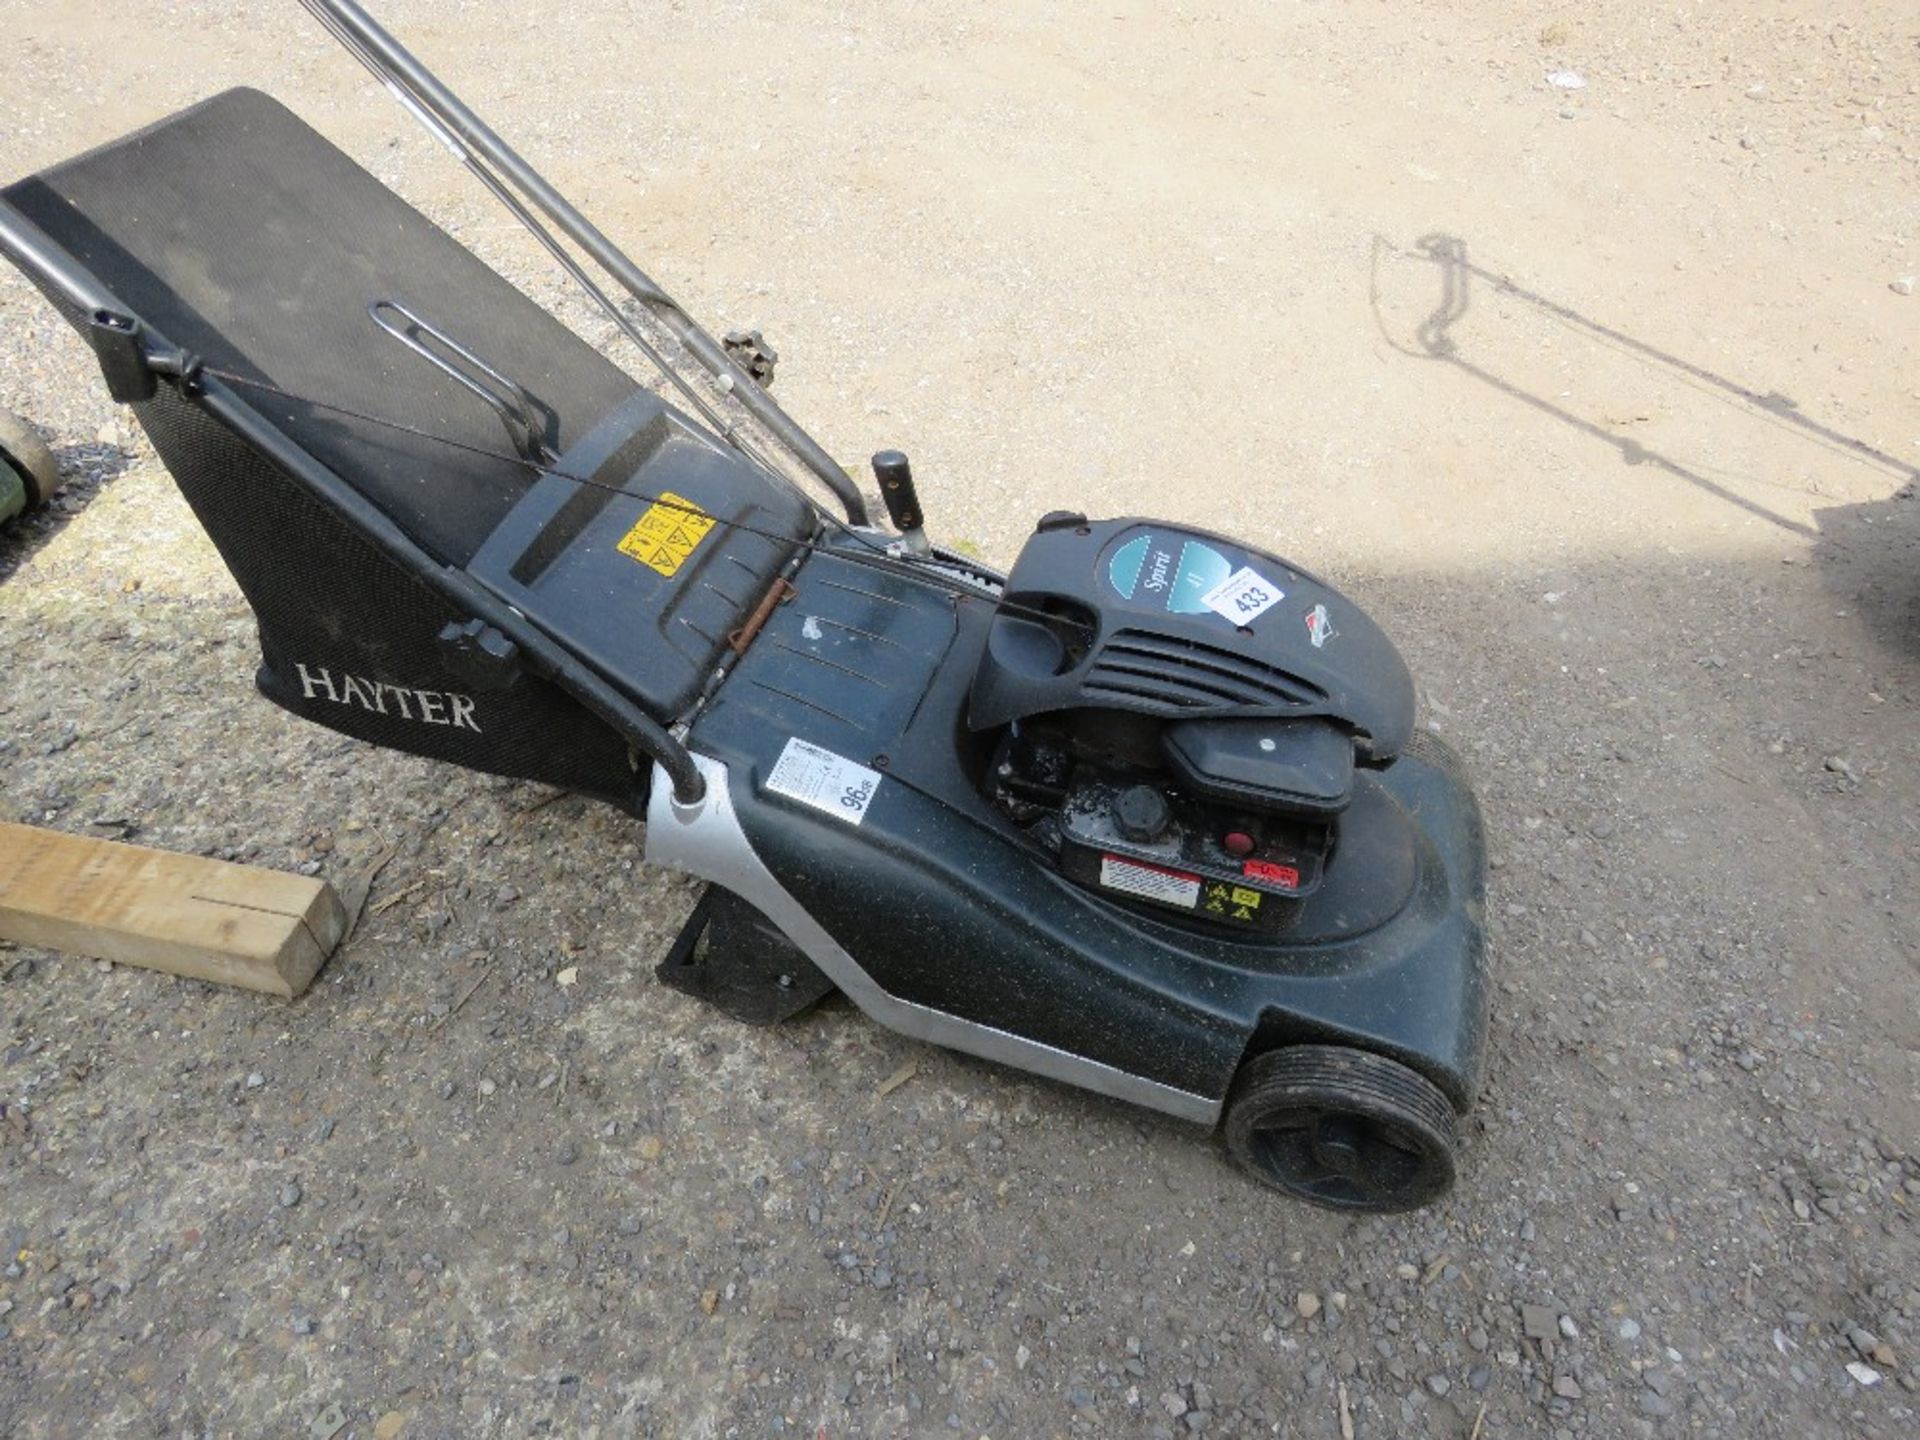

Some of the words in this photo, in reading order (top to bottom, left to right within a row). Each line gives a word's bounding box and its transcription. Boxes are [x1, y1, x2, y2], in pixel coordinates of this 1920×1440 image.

[1144, 550, 1171, 592] Spirit
[1235, 587, 1270, 613] 433
[295, 662, 482, 734] HAYTER
